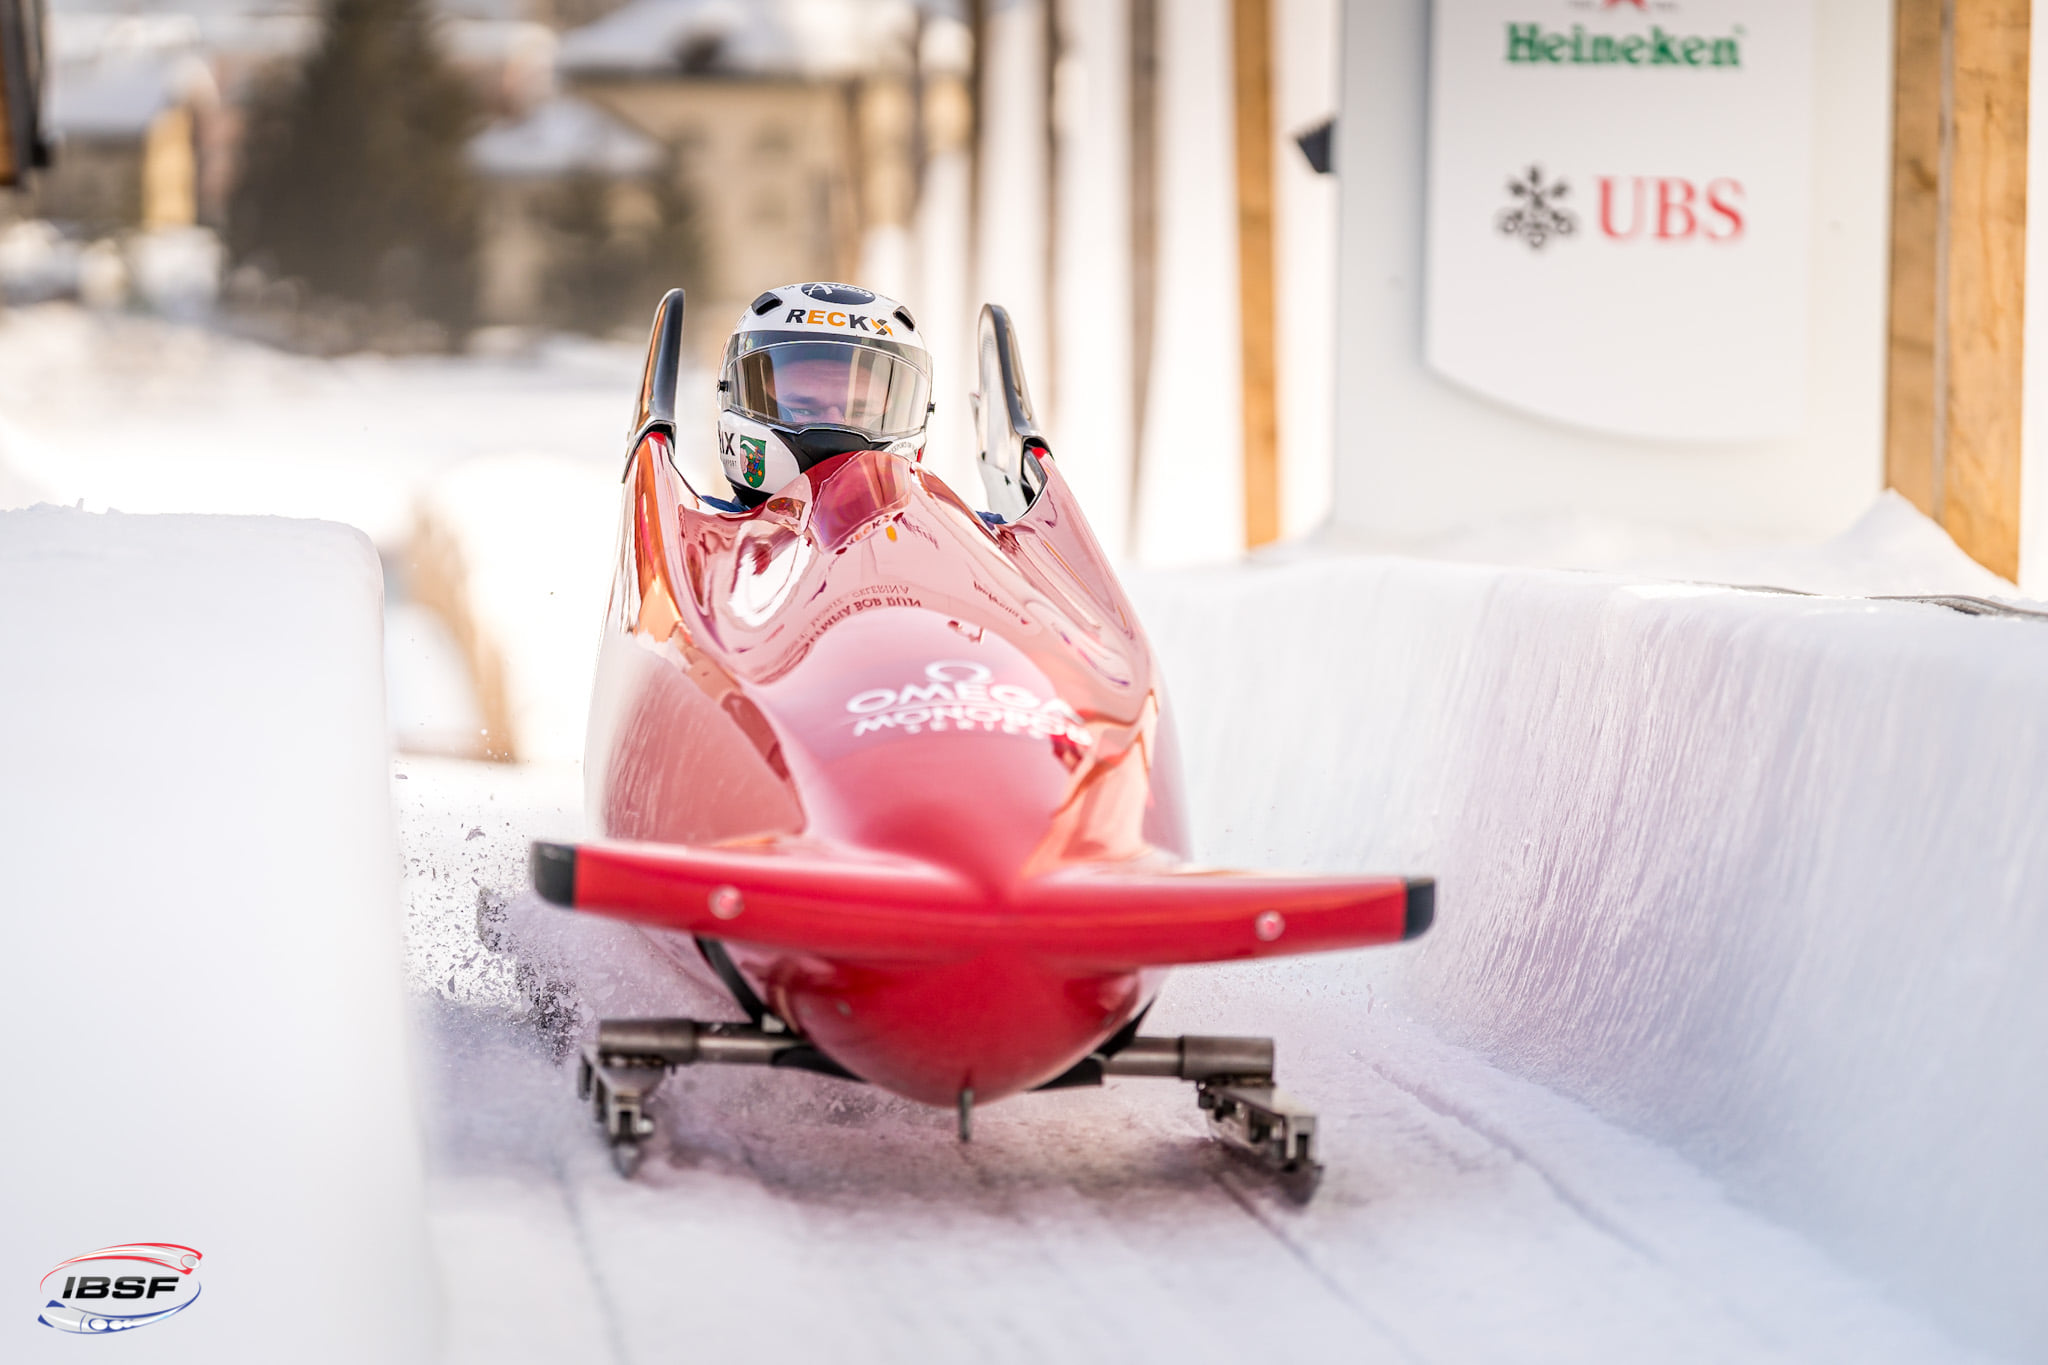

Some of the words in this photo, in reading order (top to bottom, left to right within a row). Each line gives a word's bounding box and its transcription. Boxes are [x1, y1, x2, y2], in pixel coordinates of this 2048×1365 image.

[1506, 22, 1742, 67] Heineken
[1596, 176, 1746, 242] UBS
[785, 309, 894, 336] RECKX
[846, 680, 1083, 724] OMEGA
